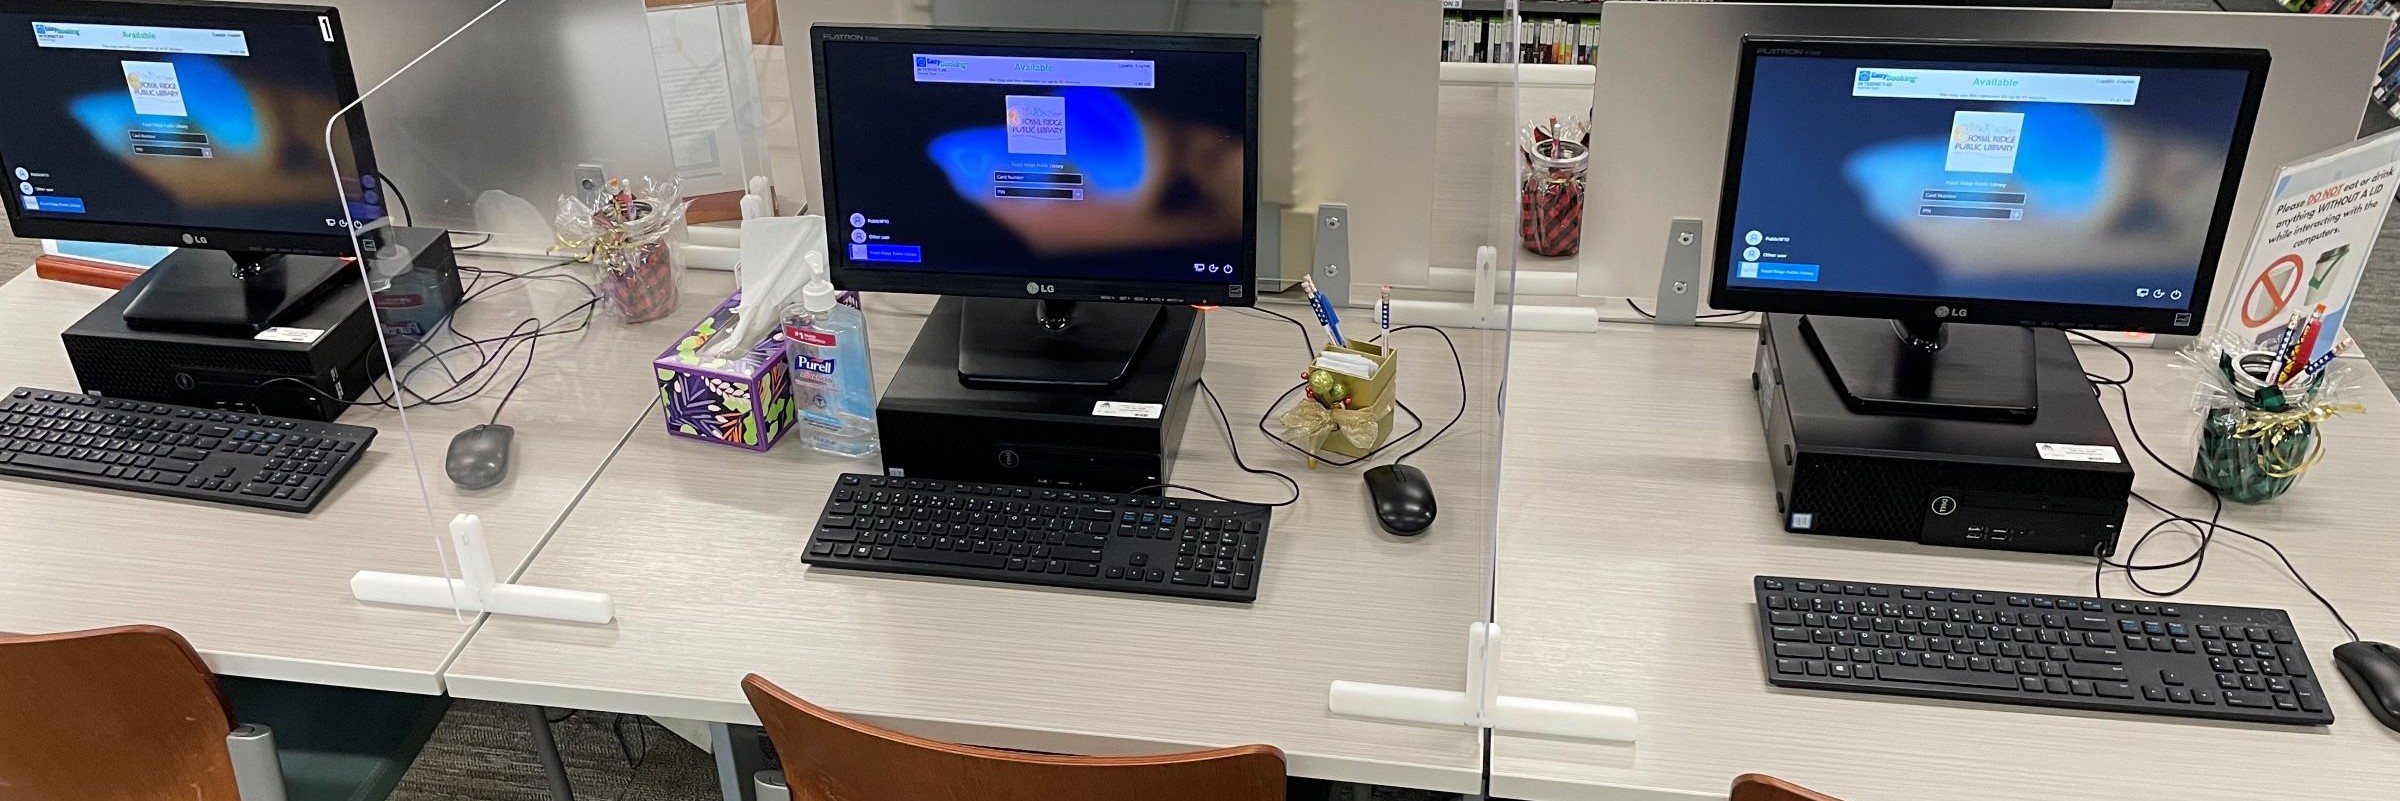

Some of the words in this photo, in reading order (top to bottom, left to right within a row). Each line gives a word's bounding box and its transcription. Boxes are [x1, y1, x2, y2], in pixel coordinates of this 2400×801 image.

[322, 19, 331, 39] 1
[1015, 63, 1053, 72] Available
[1973, 78, 2018, 87] Available
[1022, 118, 1042, 126] FOSSIL
[1043, 119, 1062, 127] RIDGE
[1012, 126, 1037, 134] PUBLIC
[1955, 143, 1981, 151] PUBLIC
[1983, 144, 2015, 152] LIBRARY
[2276, 200, 2306, 215] Please
[2306, 192, 2322, 206] DO
[2322, 183, 2344, 200] NOT
[2343, 180, 2359, 192] eat
[2359, 177, 2371, 187] or
[2371, 166, 2395, 183] drink
[2275, 209, 2316, 229] anything
[2318, 192, 2360, 214] WITHOUT
[2360, 189, 2368, 199] A
[2368, 184, 2384, 197] LID
[2268, 229, 2292, 244] while
[2293, 213, 2342, 236] interacting
[2343, 205, 2363, 218] with
[2364, 201, 2379, 212] the
[195, 236, 208, 244] LG
[2293, 227, 2341, 248] computers.
[1041, 285, 1055, 293] LG
[1951, 308, 1968, 317] LG
[798, 355, 832, 374] Purell
